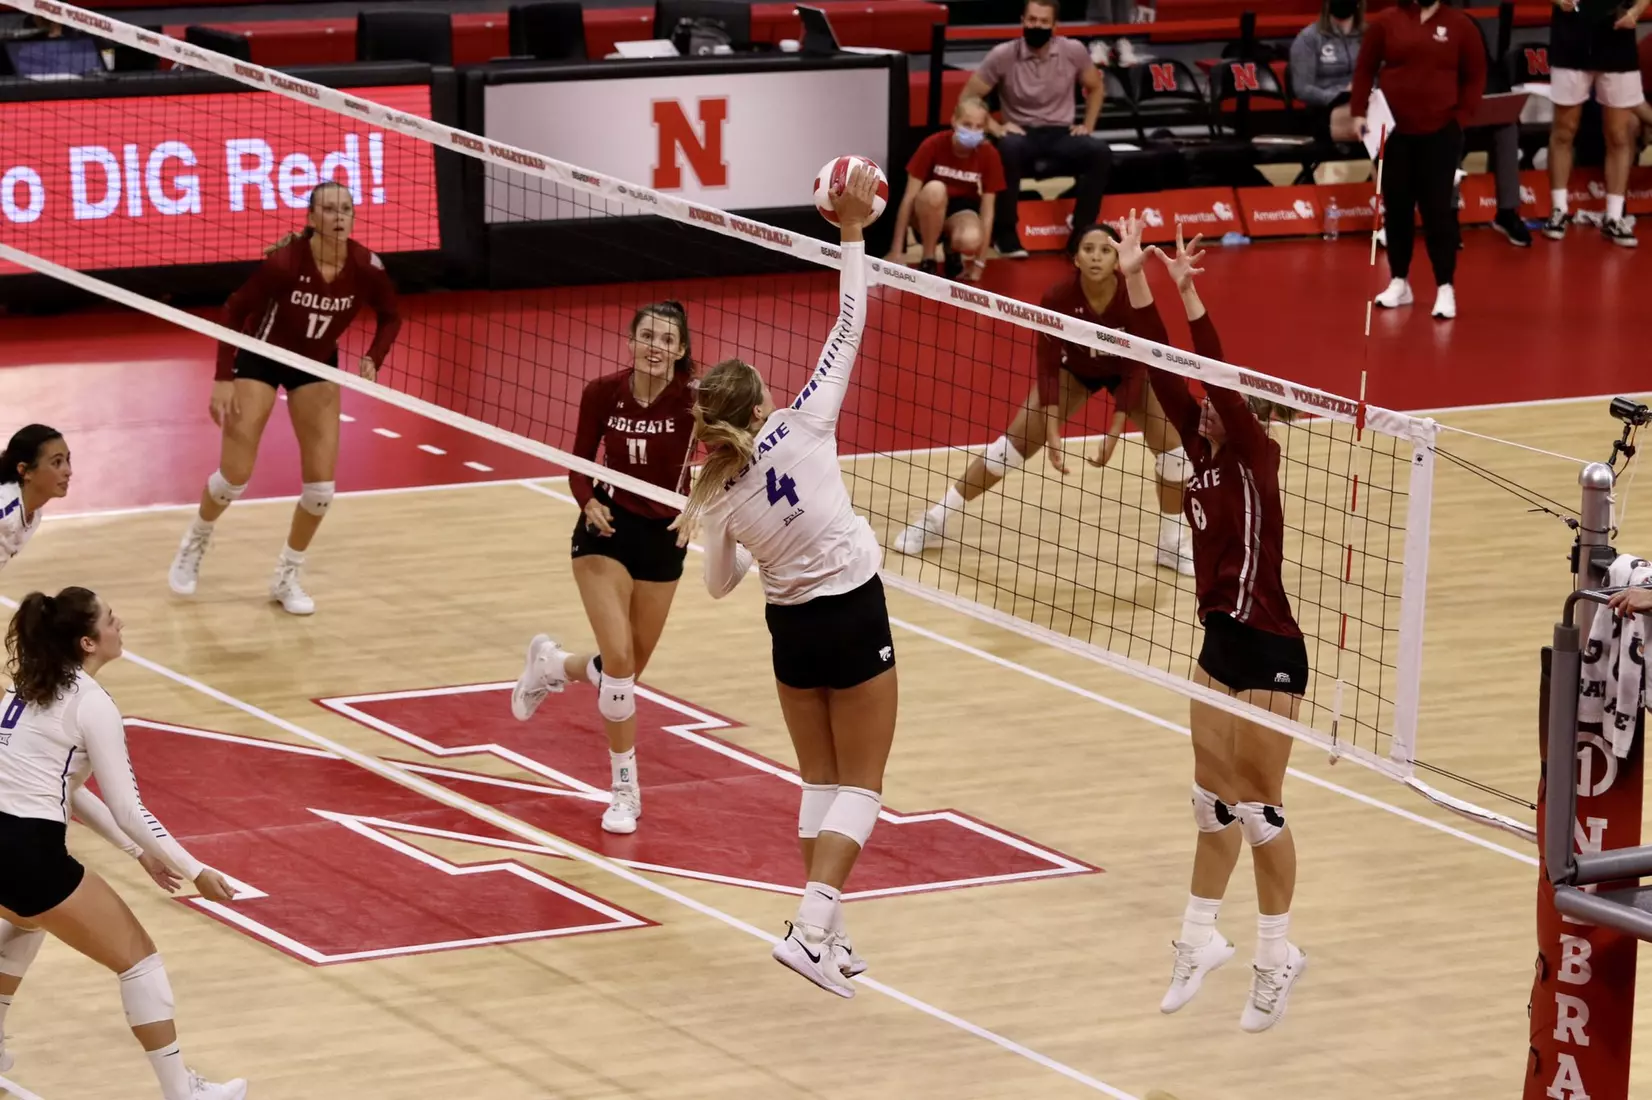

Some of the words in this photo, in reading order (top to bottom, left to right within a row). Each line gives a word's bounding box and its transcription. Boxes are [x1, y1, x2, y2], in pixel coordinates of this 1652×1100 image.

[1150, 63, 1177, 91] N
[1231, 63, 1259, 91] N
[1523, 48, 1551, 75] N
[651, 95, 730, 190] N
[69, 140, 201, 220] DIG
[225, 132, 387, 212] Red!
[689, 206, 726, 228] HUSKER
[730, 218, 793, 247] VOLLEYBALL
[883, 267, 916, 283] SUBARU
[306, 312, 333, 340] 17
[950, 285, 990, 309] HUSKER
[996, 299, 1064, 331] VOLLEYBALL
[1165, 352, 1201, 370] SUBARU
[1238, 372, 1286, 398] HUSKER
[1290, 386, 1358, 417] VOLLEYBAL
[607, 415, 676, 434] COLGATE
[626, 438, 648, 465] 11
[765, 466, 800, 507] 4
[1191, 497, 1207, 530] 8
